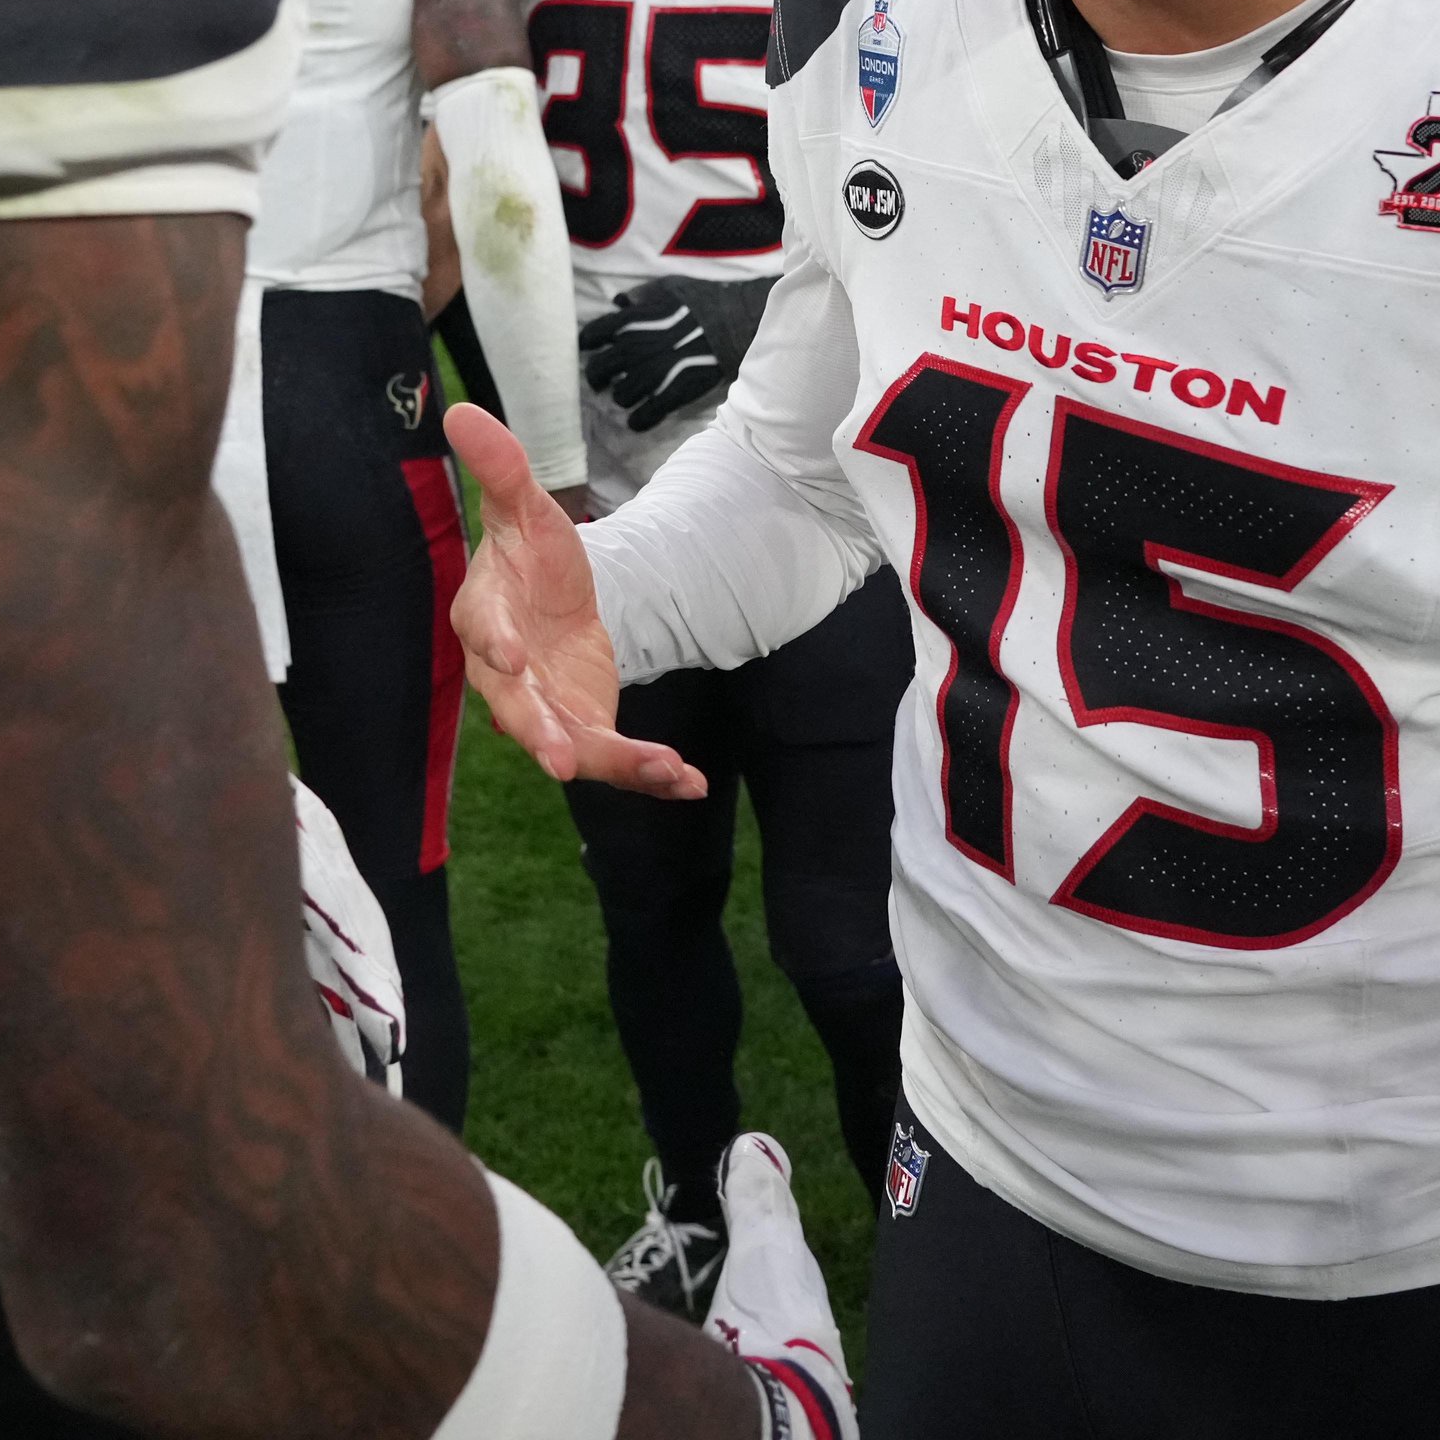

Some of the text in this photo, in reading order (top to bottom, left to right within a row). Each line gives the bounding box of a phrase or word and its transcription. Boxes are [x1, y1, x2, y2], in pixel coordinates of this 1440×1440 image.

[860, 55, 895, 77] LONDON
[874, 188, 897, 216] JSM
[1088, 241, 1133, 283] NFL
[940, 296, 1286, 426] HOUSTON
[852, 352, 1403, 951] 15
[889, 1161, 913, 1206] NFL
